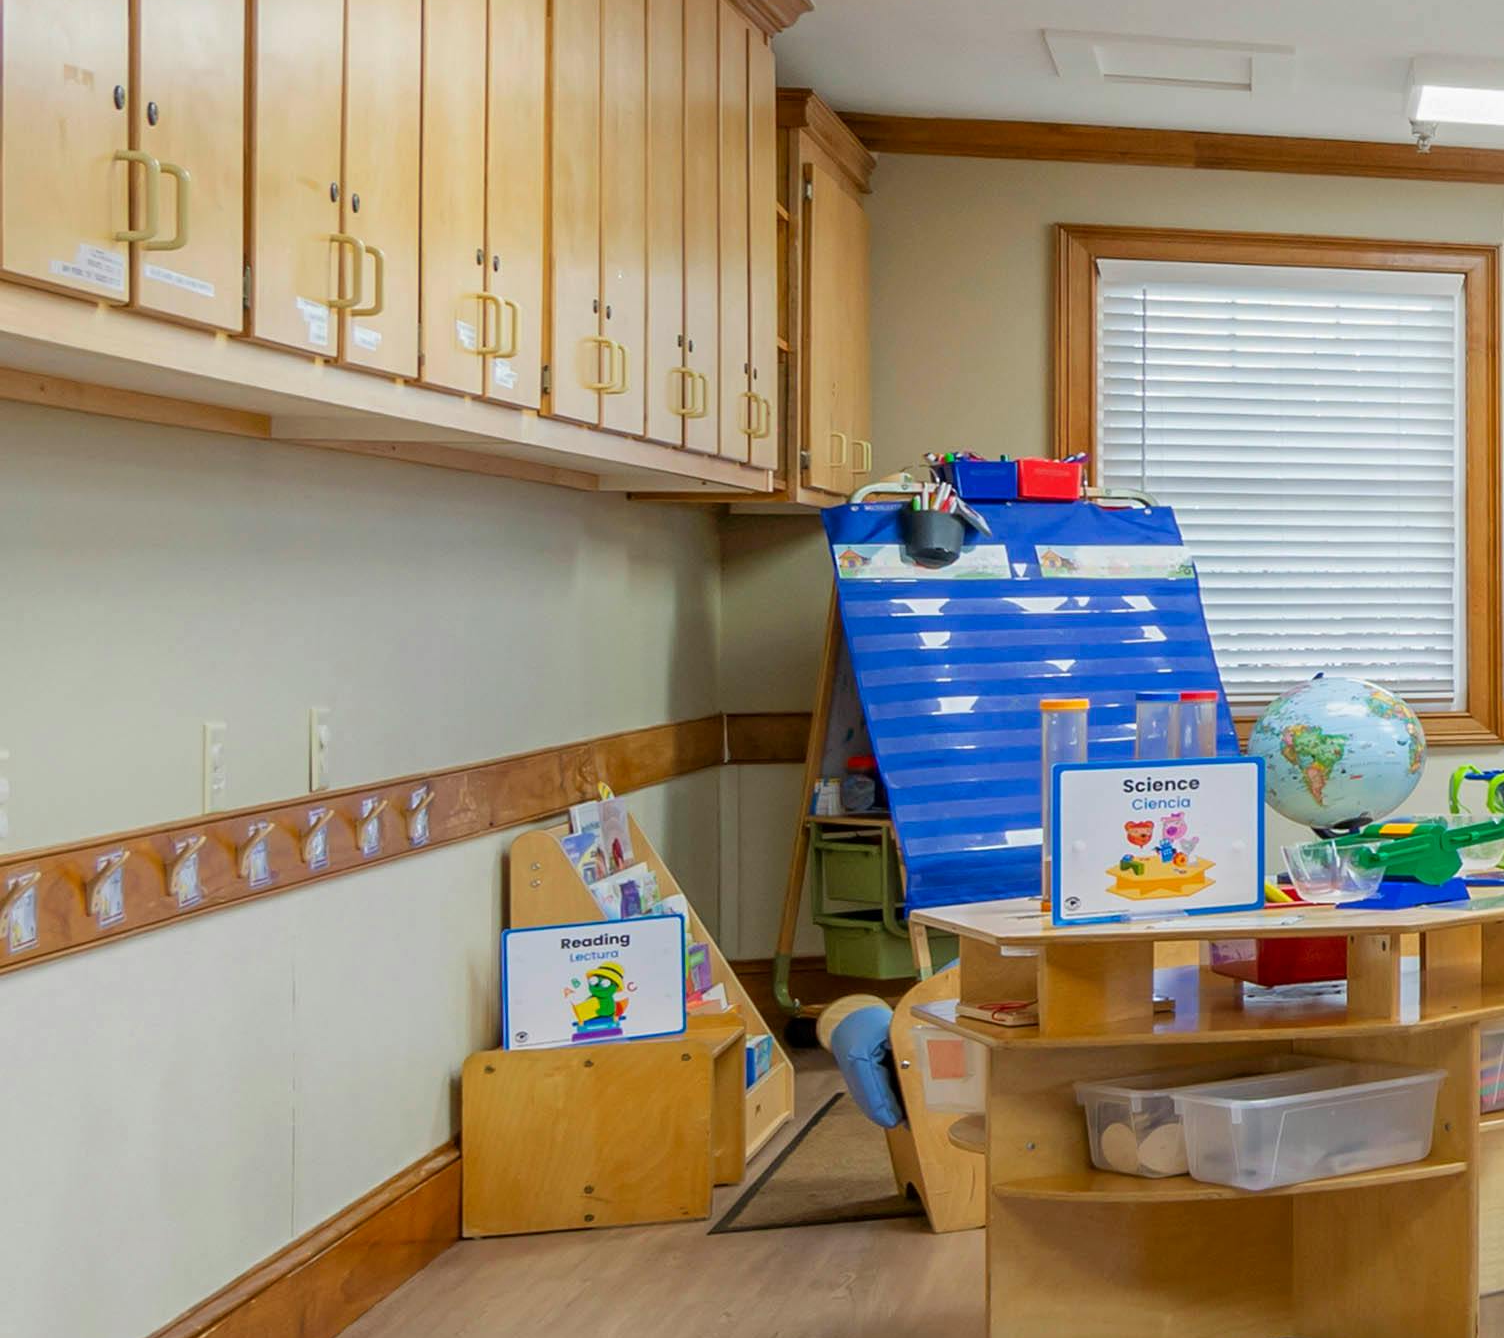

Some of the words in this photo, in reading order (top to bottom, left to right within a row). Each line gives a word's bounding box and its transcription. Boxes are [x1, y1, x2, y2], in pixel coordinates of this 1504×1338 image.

[1122, 777, 1200, 793] Science
[1131, 796, 1191, 810] Ciencia
[560, 933, 631, 950] Reading
[569, 950, 619, 963] Lectura
